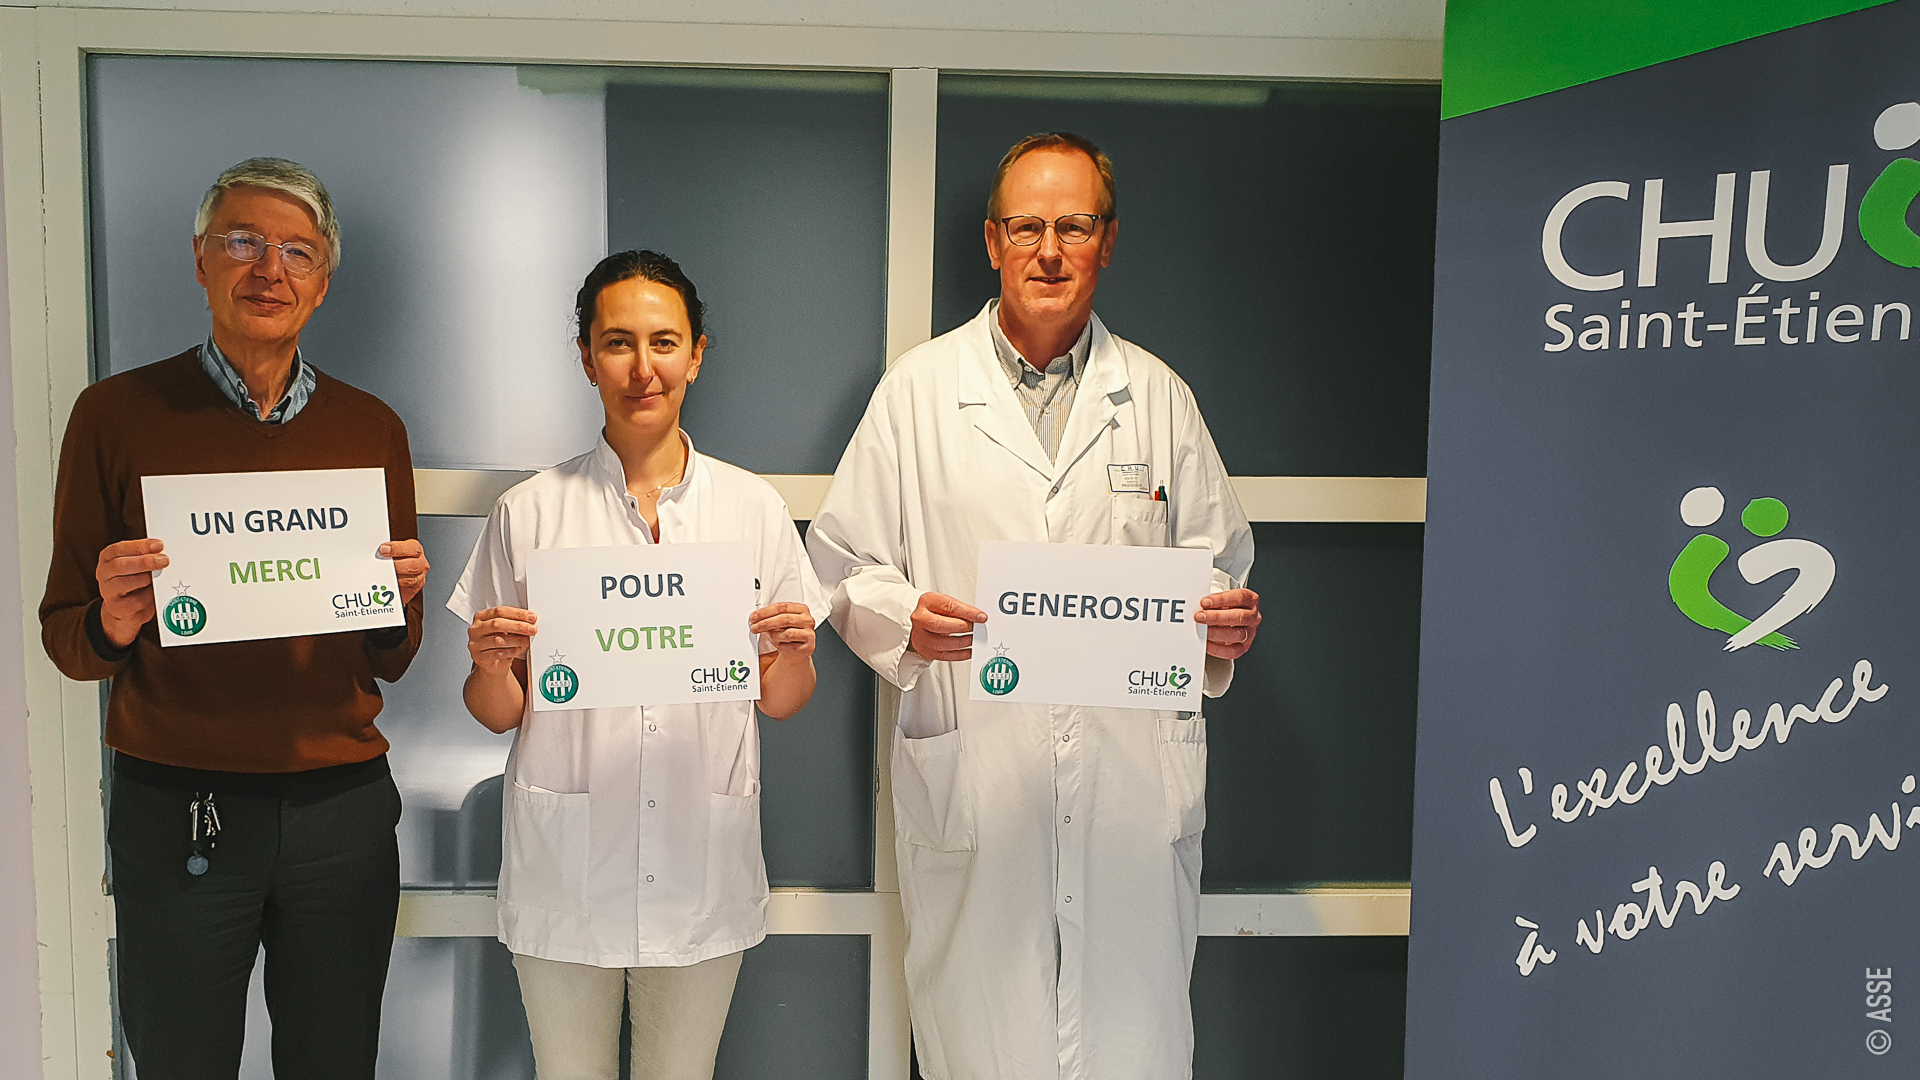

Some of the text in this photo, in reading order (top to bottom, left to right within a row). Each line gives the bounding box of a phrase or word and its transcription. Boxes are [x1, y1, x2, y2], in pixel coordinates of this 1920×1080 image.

[1542, 164, 1849, 291] CHU
[191, 507, 348, 535] UN GRAND
[229, 558, 321, 584] MERCI
[601, 573, 685, 599] POUR
[332, 592, 372, 609] CHU
[335, 607, 394, 618] Saint-Étienne
[999, 591, 1186, 623] GENEROSITE
[595, 625, 694, 652] VOTRE
[691, 667, 728, 683] CHU
[692, 683, 748, 692] Saint-Étienne
[1128, 670, 1168, 686] CHU
[1128, 686, 1187, 697] Saint-Étienne
[1490, 660, 1889, 847] L'excellence
[1516, 916, 1556, 976] à
[1576, 866, 1740, 953] votre
